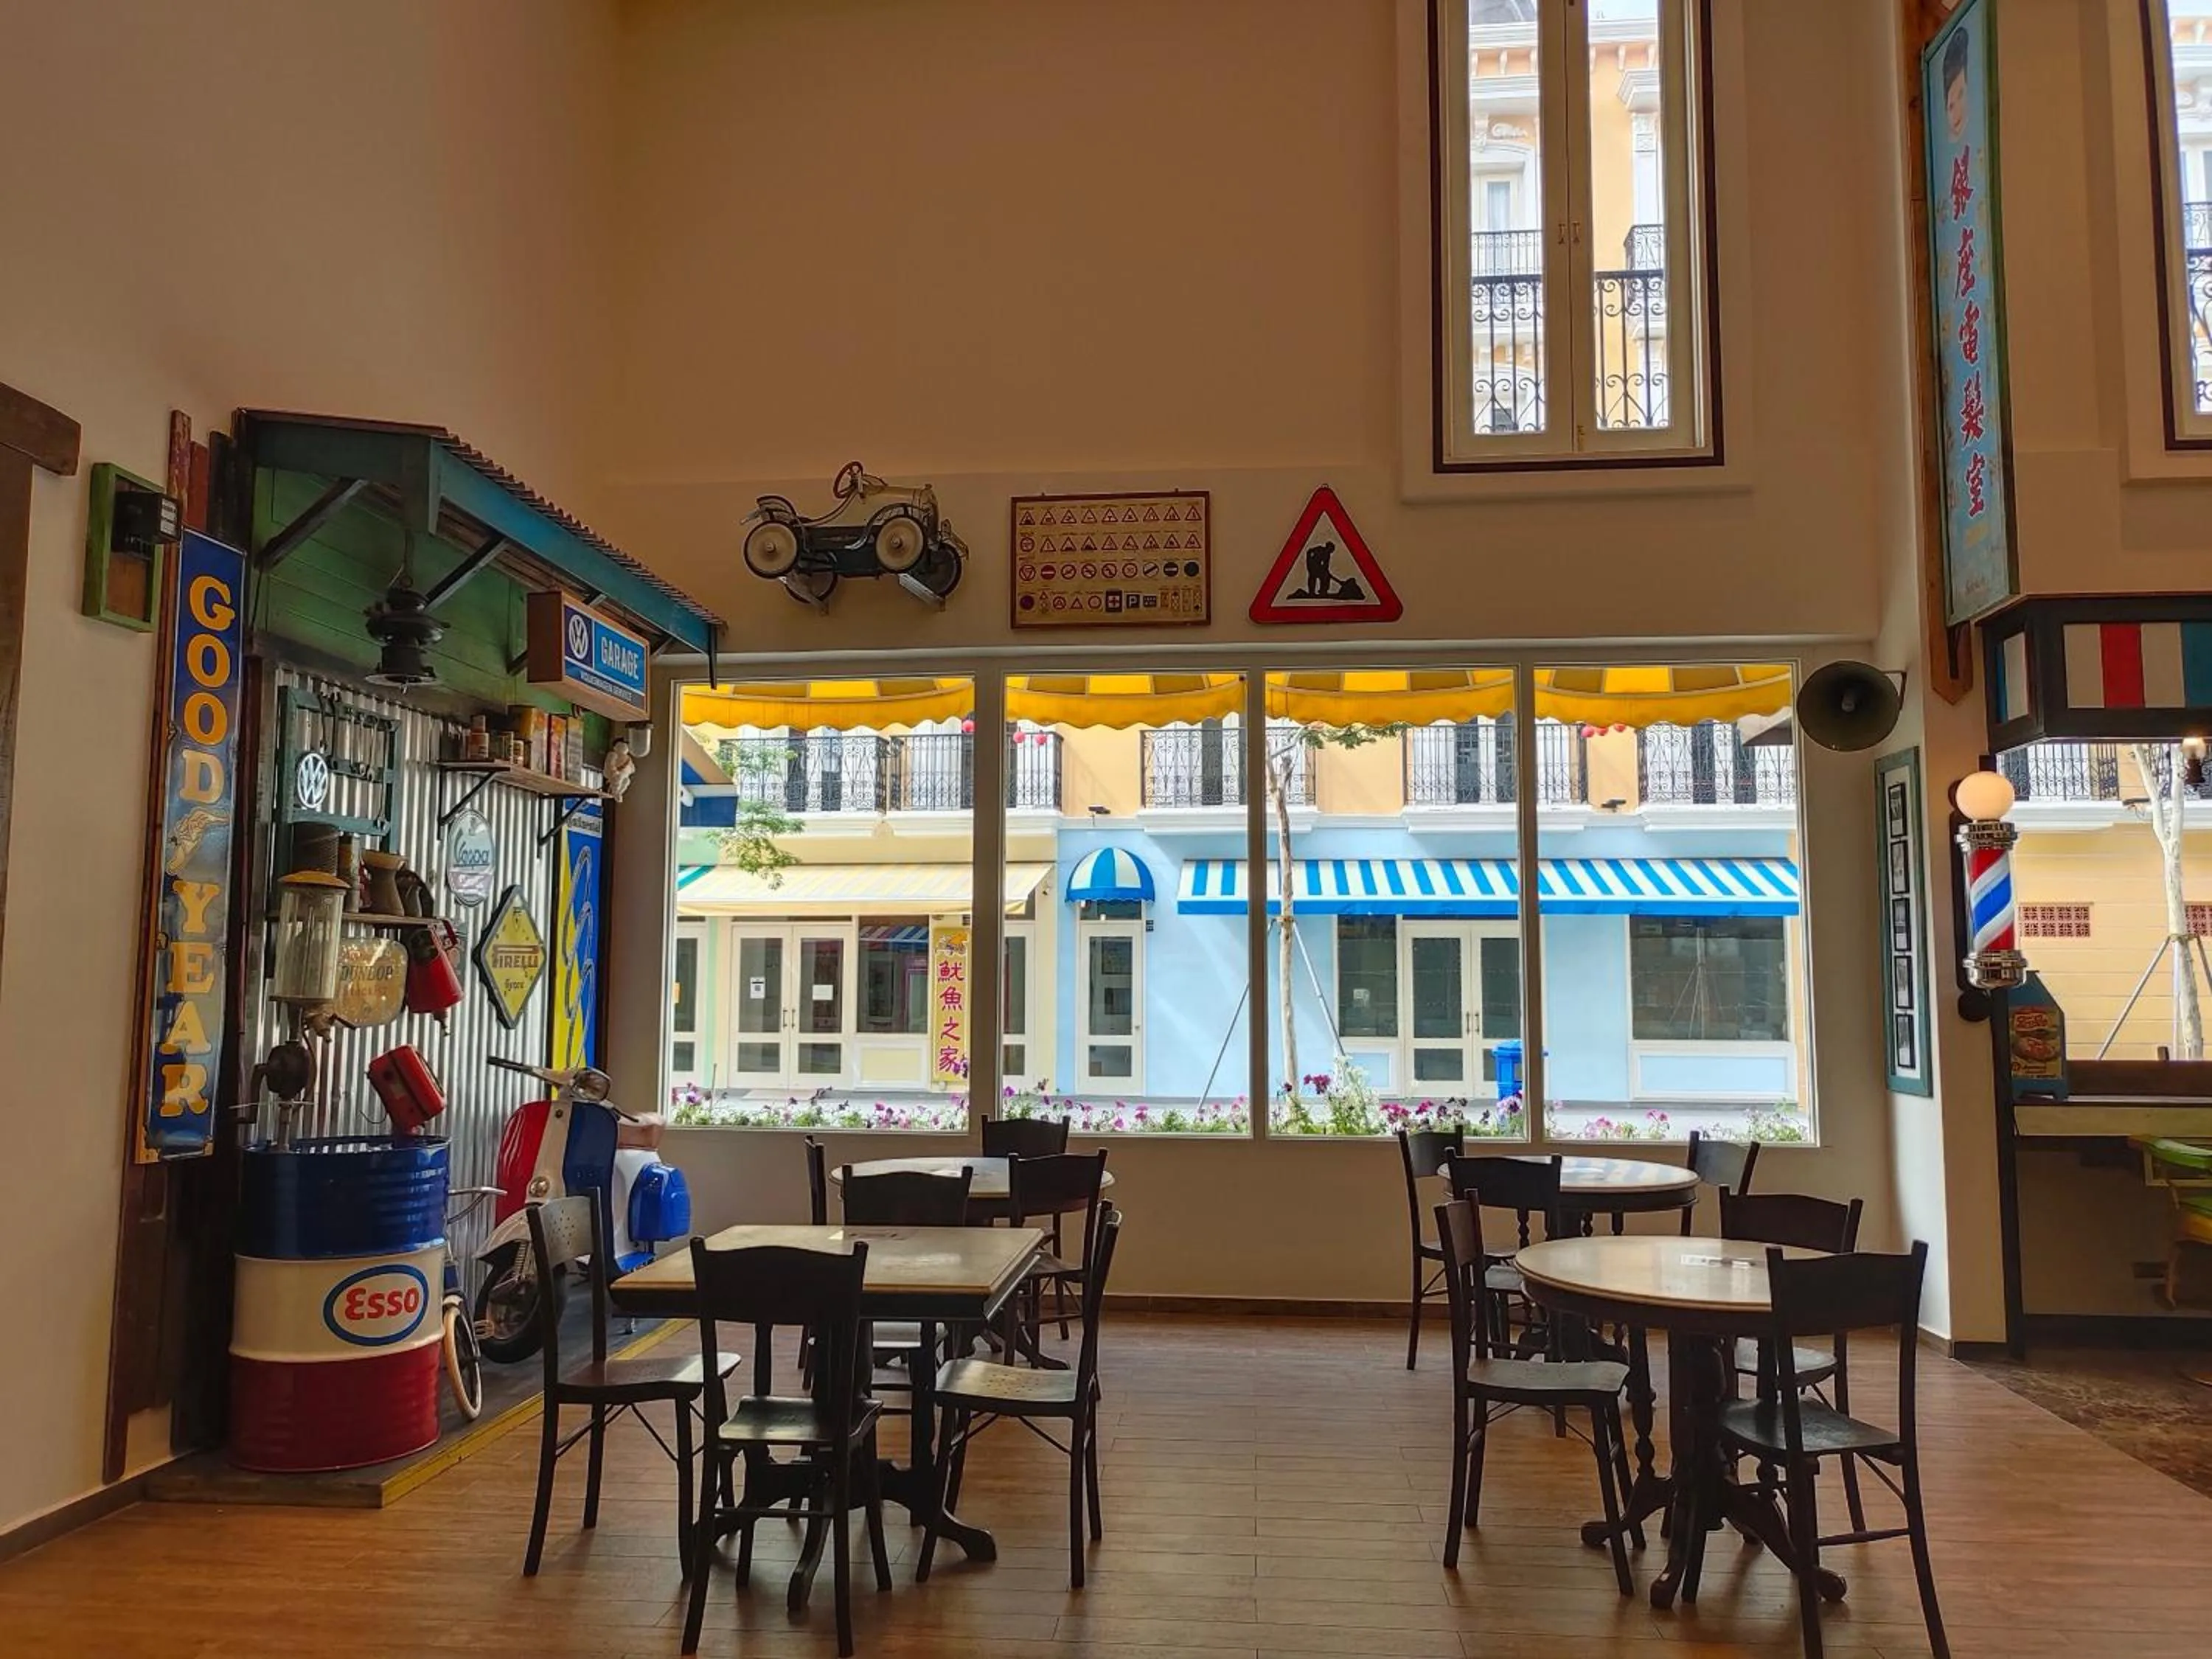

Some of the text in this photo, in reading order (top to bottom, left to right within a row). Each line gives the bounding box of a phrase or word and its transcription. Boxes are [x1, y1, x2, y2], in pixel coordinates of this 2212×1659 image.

[601, 636, 639, 680] GARAGE
[341, 965, 393, 981] DUNLOP
[491, 956, 540, 969] PIRELLI
[937, 960, 964, 1072] 魷魚之家
